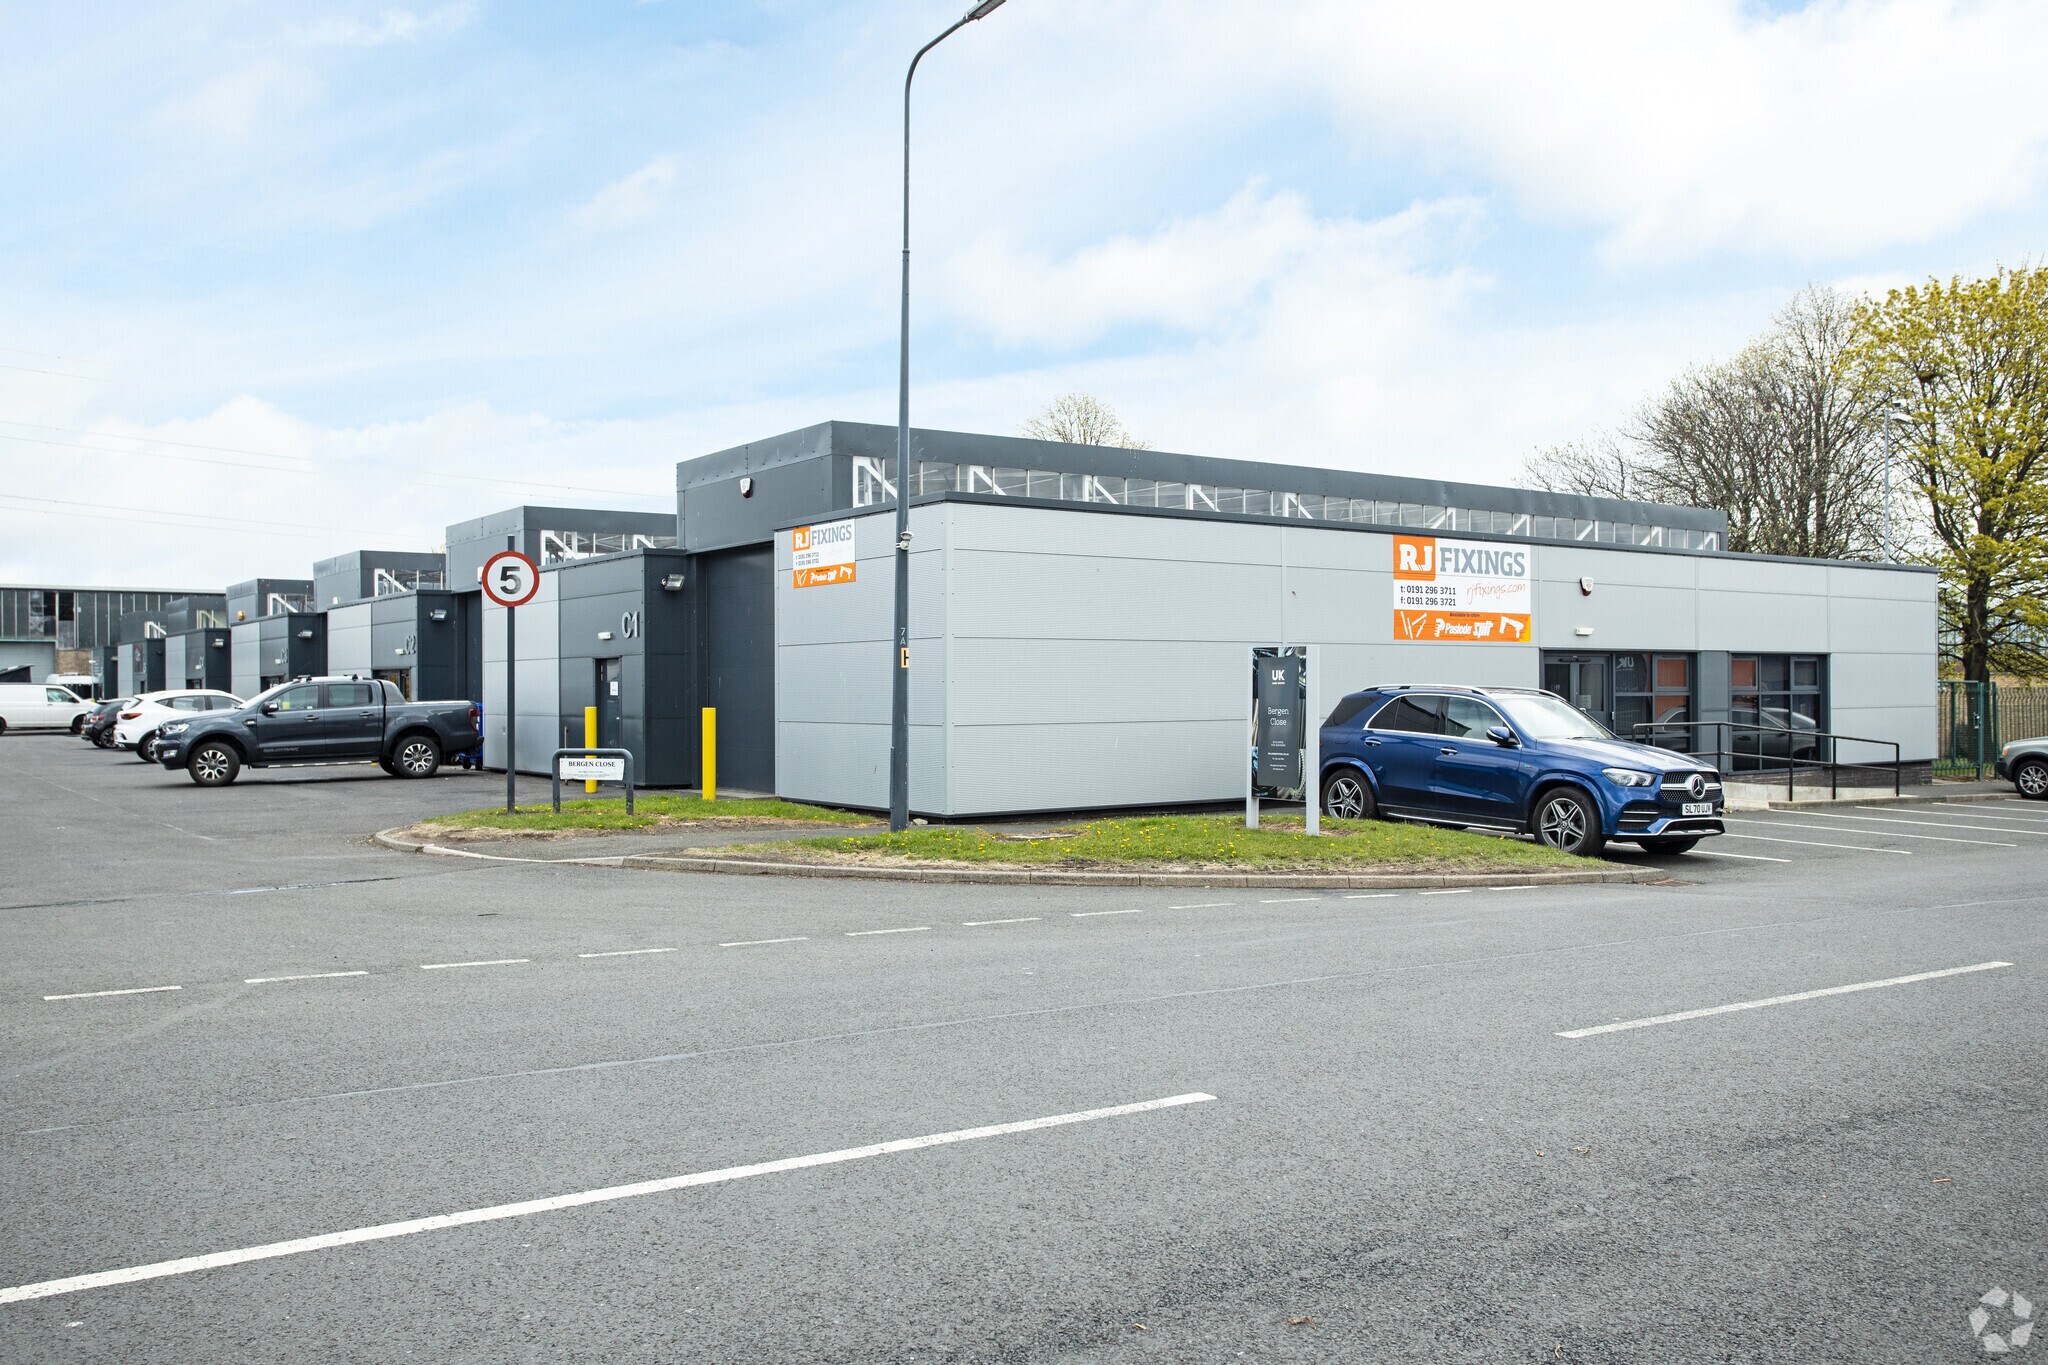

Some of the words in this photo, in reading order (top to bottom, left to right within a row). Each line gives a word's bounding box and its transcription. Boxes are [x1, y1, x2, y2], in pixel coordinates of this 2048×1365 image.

[795, 531, 810, 549] RJ
[811, 524, 852, 546] FIXINGS
[1399, 543, 1433, 572] RJ
[1440, 547, 1525, 577] FIXINGS
[500, 566, 522, 595] 5
[1400, 585, 1406, 593] t:
[1406, 585, 1424, 594] 0191
[1425, 586, 1438, 594] 296
[1440, 586, 1457, 595] 3711
[1466, 582, 1526, 605] rjfixings.com
[1400, 597, 1406, 605] f:
[1406, 597, 1424, 605] 0191
[1425, 597, 1438, 606] 296
[1440, 598, 1457, 606] 3721
[621, 611, 640, 638] C1
[1444, 622, 1473, 635] Paslode
[1272, 669, 1285, 681] UK
[1267, 707, 1289, 716] Bergen
[1269, 718, 1287, 726] Close
[1685, 804, 1700, 814] SL70
